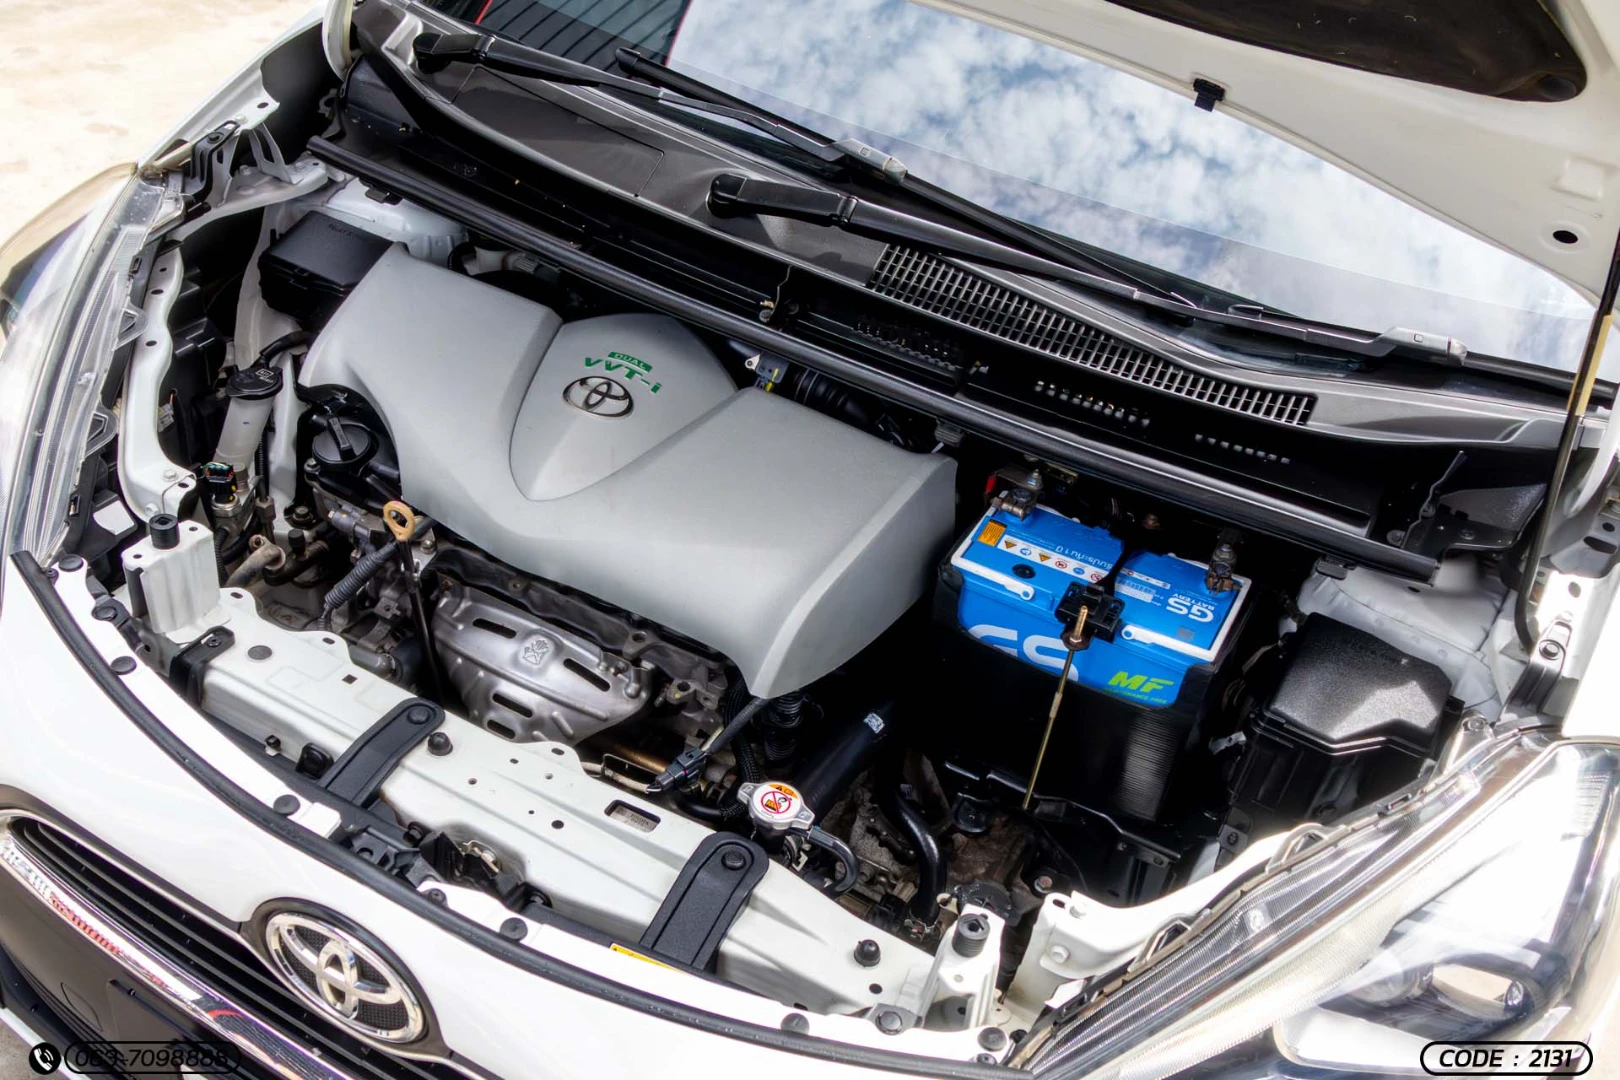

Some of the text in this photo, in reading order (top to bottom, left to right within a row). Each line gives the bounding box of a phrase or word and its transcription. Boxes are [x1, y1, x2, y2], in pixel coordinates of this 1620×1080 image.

[613, 352, 646, 370] DUAL
[585, 357, 662, 393] VVT-i
[1166, 597, 1214, 623] GS
[1172, 593, 1215, 611] BATTERY
[1108, 671, 1174, 693] MF
